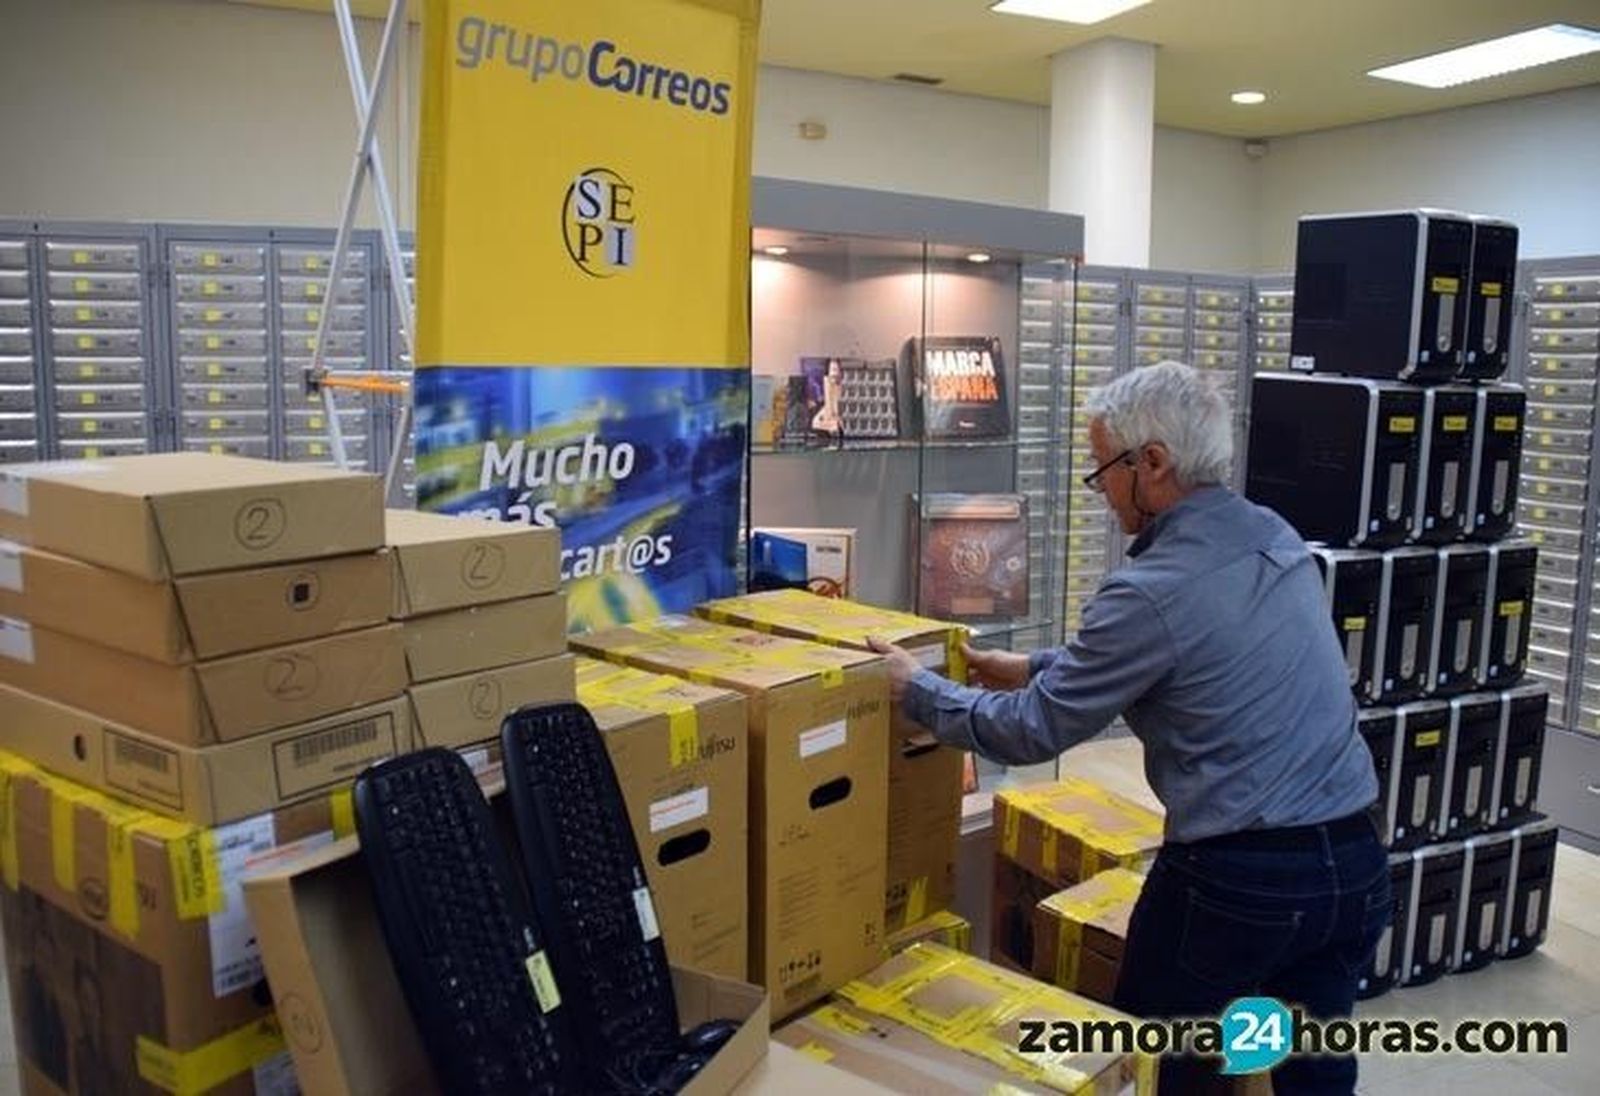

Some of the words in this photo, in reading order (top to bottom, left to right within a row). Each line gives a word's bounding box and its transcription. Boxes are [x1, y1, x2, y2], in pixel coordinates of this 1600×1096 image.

[925, 350, 996, 377] MARCA
[480, 433, 634, 491] Mucho
[458, 491, 557, 528] ás
